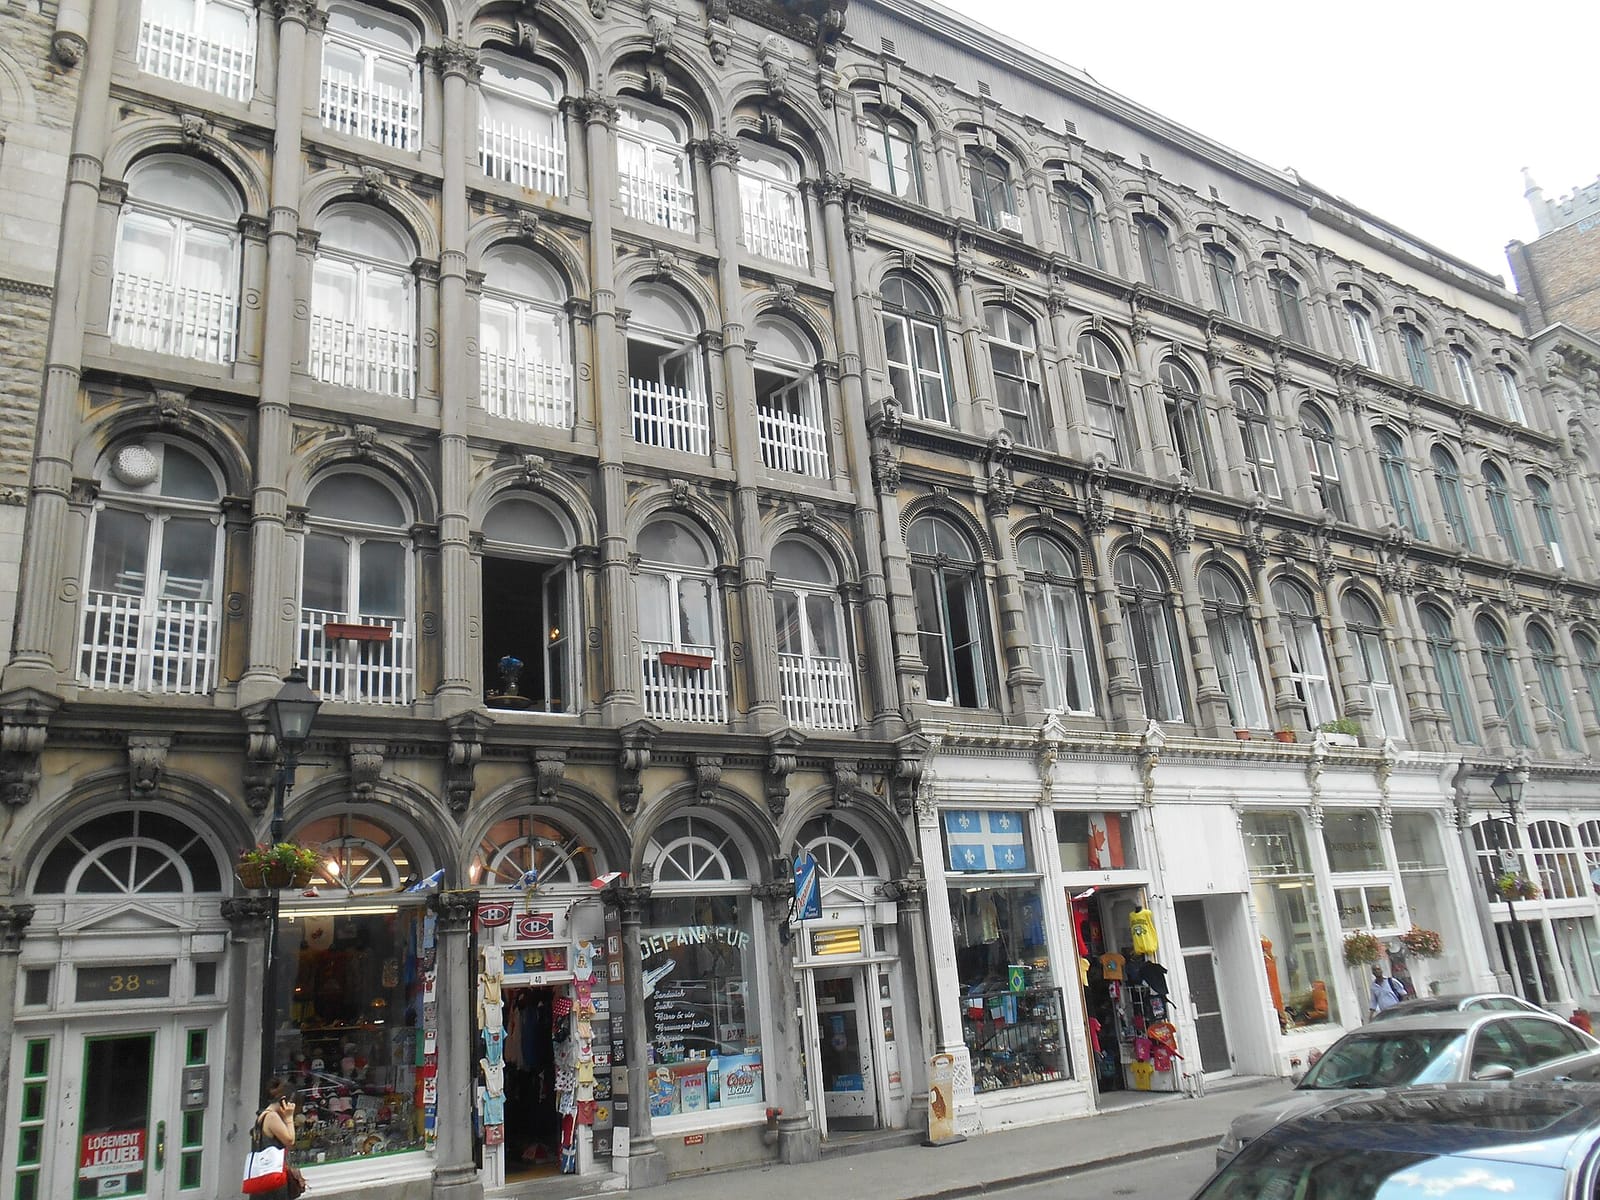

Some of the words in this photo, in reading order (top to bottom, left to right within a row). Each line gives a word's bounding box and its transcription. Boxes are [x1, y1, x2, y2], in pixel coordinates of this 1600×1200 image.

[108, 975, 140, 992] 38
[535, 976, 542, 984] 40
[677, 1011, 683, 1019] &
[727, 1028, 745, 1040] ATM
[685, 1079, 702, 1088] ATM
[727, 1073, 753, 1087] Coors
[727, 1085, 753, 1096] LIGHT
[88, 1132, 140, 1150] LOGEMENT
[94, 1146, 139, 1165] LOUER
